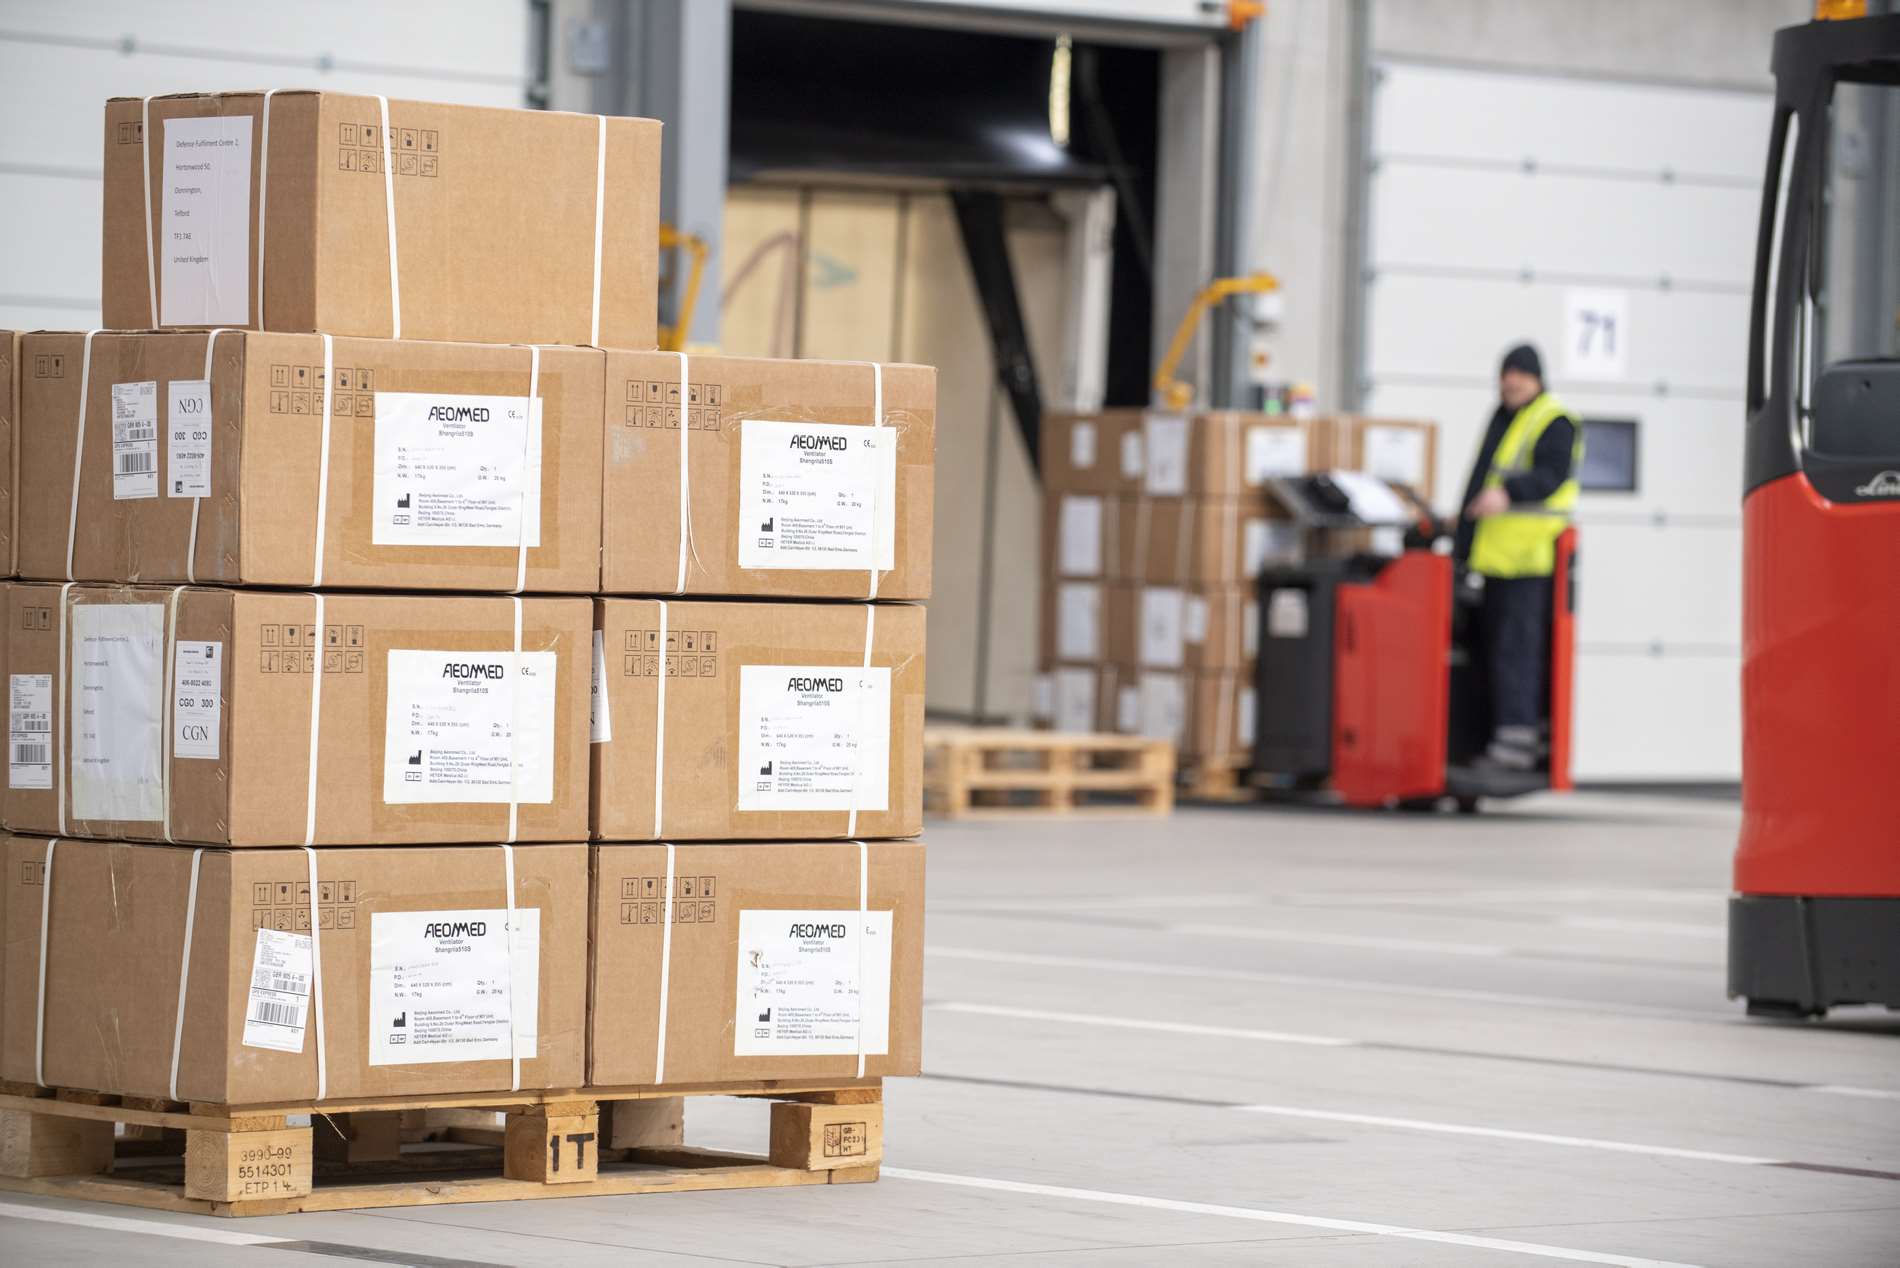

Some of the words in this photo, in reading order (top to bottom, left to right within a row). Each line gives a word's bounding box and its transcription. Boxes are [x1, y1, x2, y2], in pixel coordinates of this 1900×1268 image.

[1577, 309, 1617, 356] 71
[178, 398, 204, 414] CGN
[174, 431, 187, 441] 300
[179, 698, 195, 707] CGO
[201, 698, 214, 708] 300
[183, 725, 209, 741] CGN
[239, 1163, 292, 1179] 5514301
